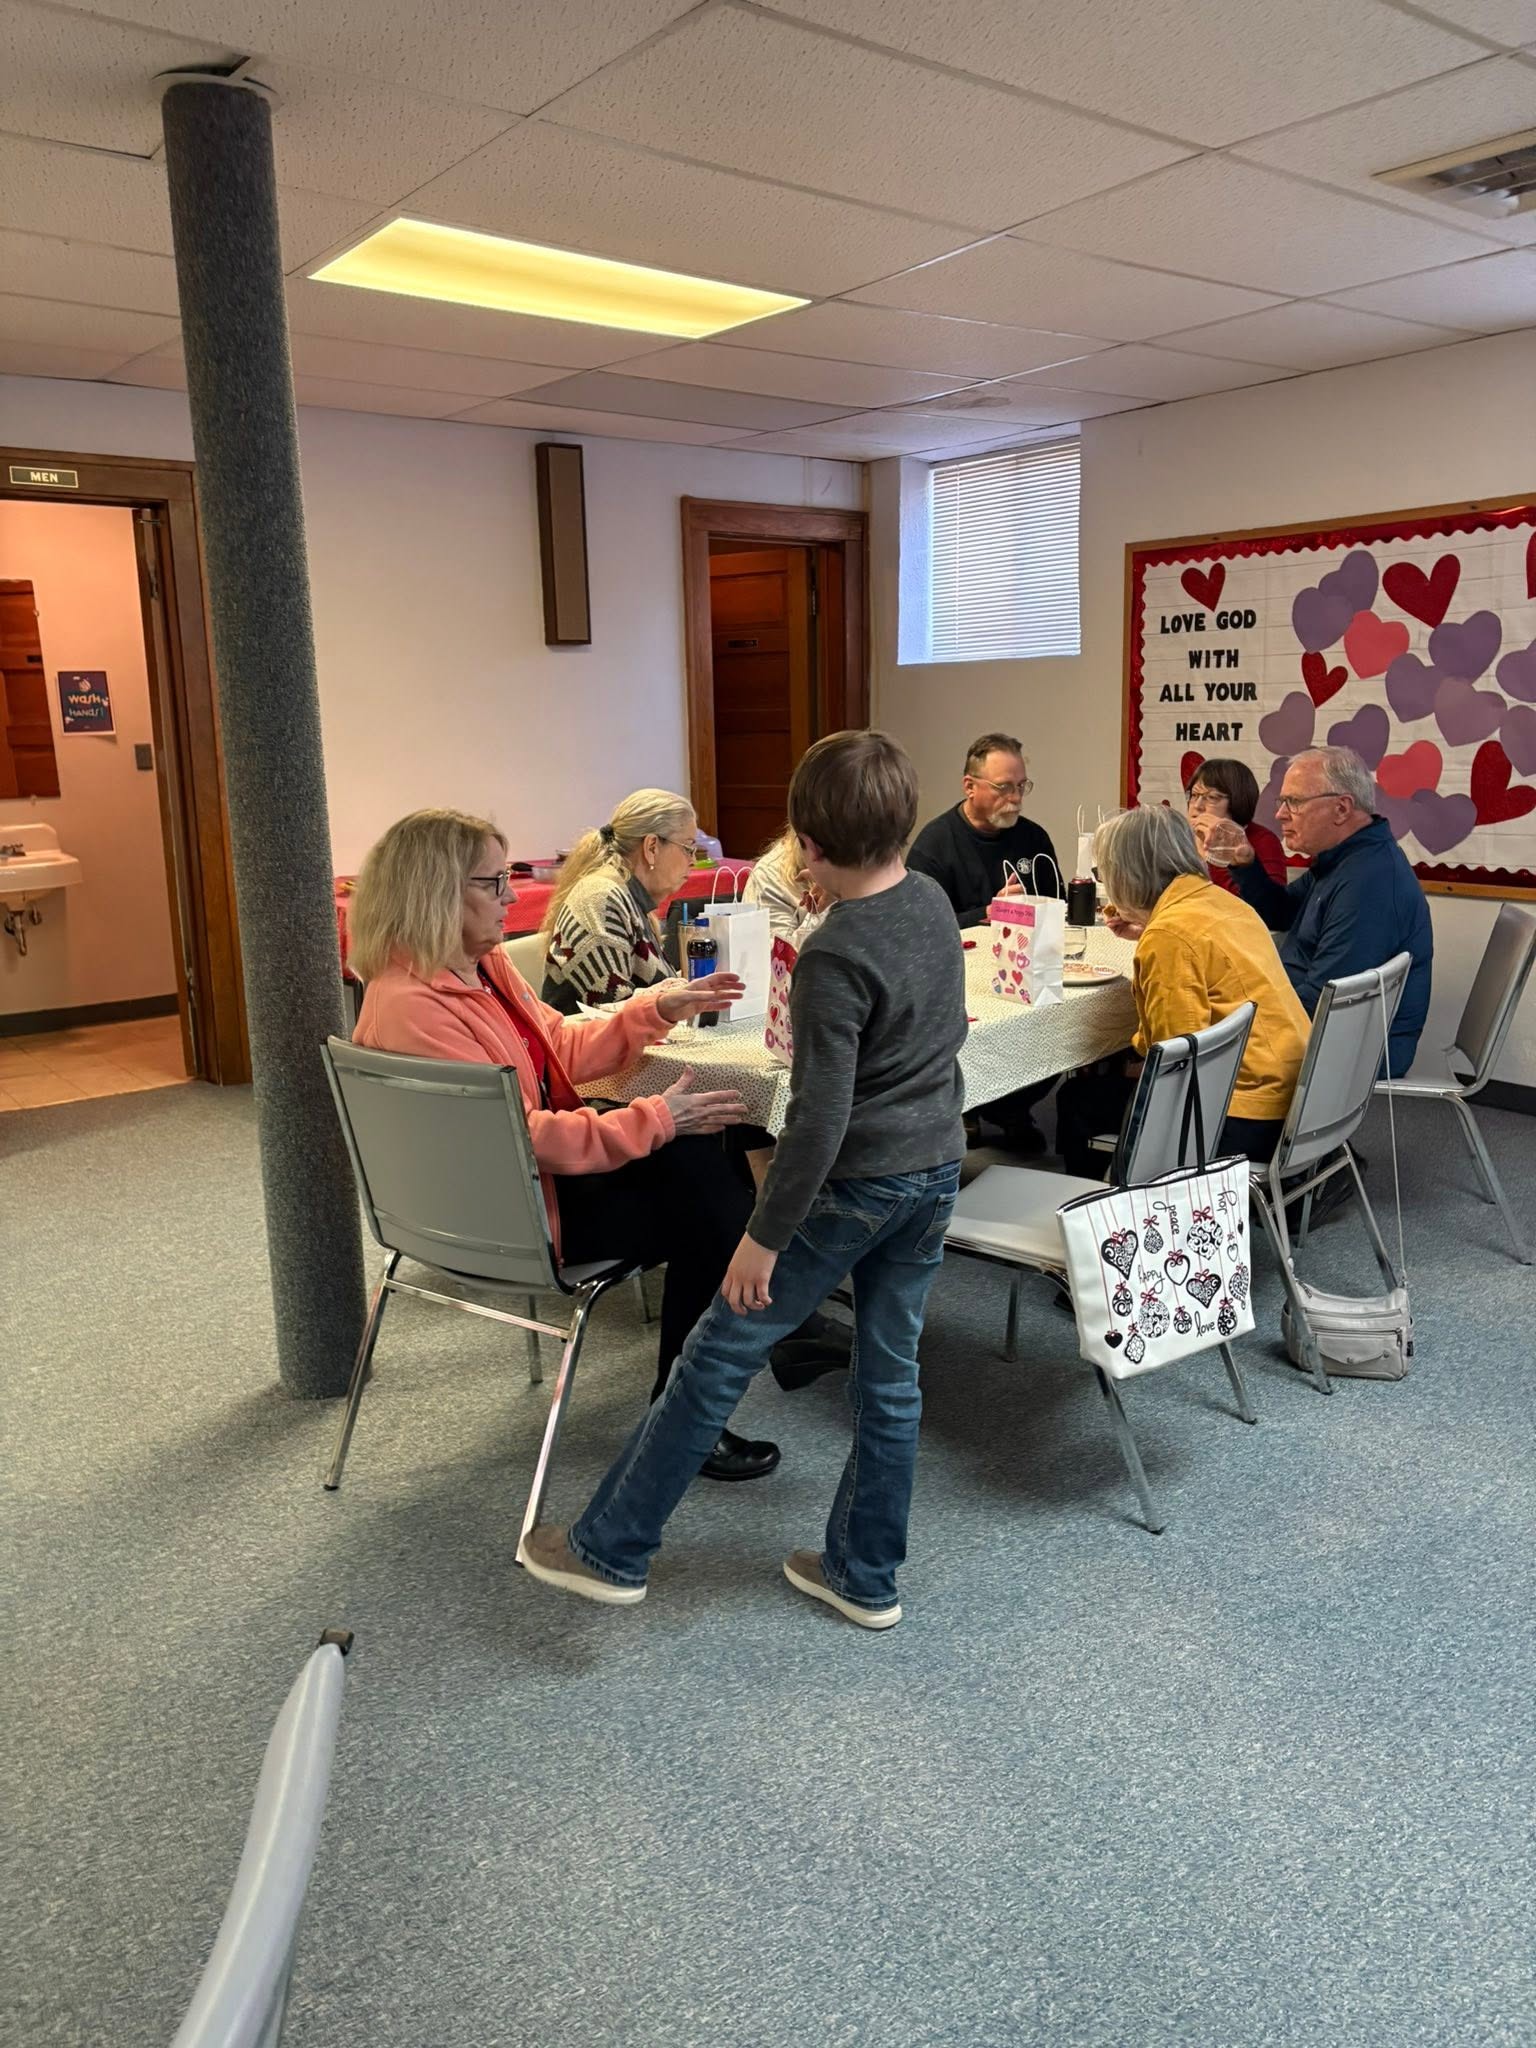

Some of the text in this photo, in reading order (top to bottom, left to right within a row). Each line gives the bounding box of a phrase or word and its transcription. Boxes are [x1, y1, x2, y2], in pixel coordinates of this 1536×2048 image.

[30, 471, 59, 483] MEN
[1160, 609, 1257, 634] LOVE GOD
[1188, 649, 1239, 669] WITH
[1159, 682, 1258, 702] ALL YOUR
[1175, 722, 1244, 742] HEART
[1152, 1201, 1180, 1235] peace
[1194, 1310, 1216, 1338] love
